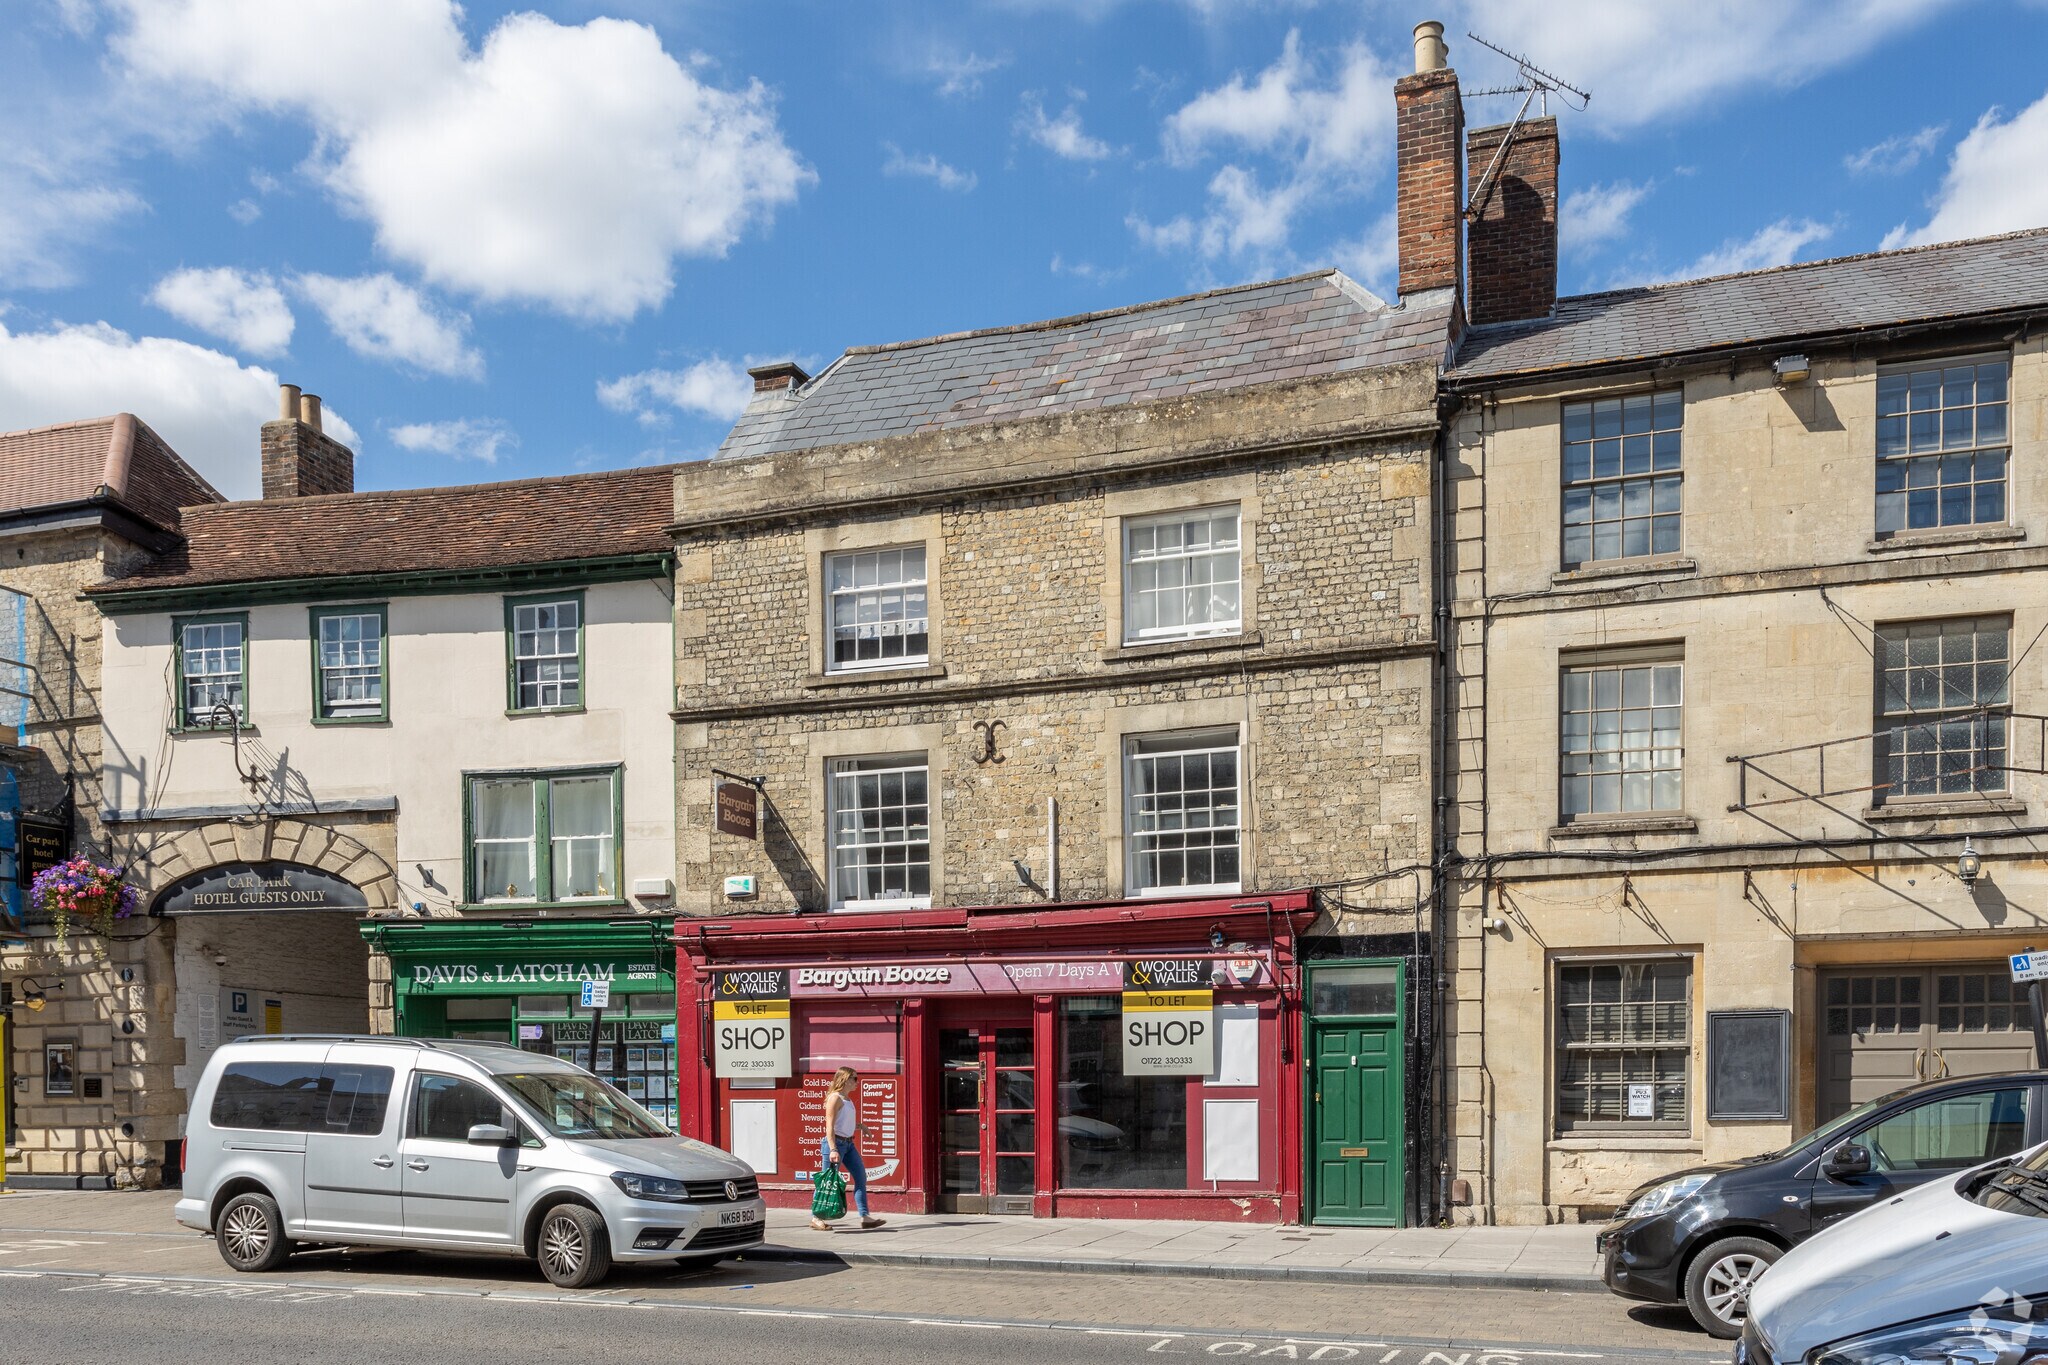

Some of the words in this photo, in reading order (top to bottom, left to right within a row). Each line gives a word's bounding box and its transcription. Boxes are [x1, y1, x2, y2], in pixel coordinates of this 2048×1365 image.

[719, 792, 755, 812] Bargain
[723, 808, 751, 827] Booze
[25, 834, 41, 843] Car
[42, 837, 60, 846] park
[33, 847, 54, 858] hotel
[227, 876, 254, 889] CAR
[257, 875, 292, 888] PARK
[194, 893, 237, 905] HOTEL
[239, 891, 288, 904] GUESTS
[290, 890, 326, 902] ONLY
[627, 963, 656, 971] ESTATE
[1003, 964, 1042, 981] Open
[1046, 963, 1055, 977] 7
[1058, 962, 1095, 980] Days
[1097, 962, 1110, 976] A
[1140, 960, 1202, 973] WOOLLEY
[413, 964, 480, 983] DAVIS
[481, 971, 494, 983] &
[495, 963, 616, 983] LATCHAM
[627, 972, 657, 980] AGENTS
[729, 971, 781, 984] WOOLLEY
[797, 966, 882, 990] Bargain
[882, 965, 949, 984] Booze
[1132, 961, 1151, 985] &
[1154, 970, 1198, 984] WALLIS
[585, 983, 592, 993] P
[722, 973, 739, 995] &
[741, 982, 778, 994] WALLIS
[235, 994, 245, 1011] P
[1148, 996, 1164, 1006] TO
[1168, 996, 1186, 1006] LET
[736, 1005, 749, 1015] TO
[752, 1004, 767, 1014] LET
[558, 1022, 588, 1030] DAVIS
[628, 1021, 659, 1030] DAVIS
[558, 1030, 612, 1040] LATCHM
[628, 1030, 662, 1039] LATCH
[721, 1027, 785, 1050] SHOP
[1128, 1020, 1205, 1047] SHOP
[731, 1060, 748, 1068] 01722
[1141, 1057, 1162, 1065] 01722
[1165, 1056, 1193, 1065] 330333
[803, 1078, 820, 1087] Cold
[863, 1082, 893, 1091] Opening
[798, 1090, 823, 1098] Chilled
[799, 1102, 822, 1110] Ciders
[721, 1211, 741, 1225] NK68
